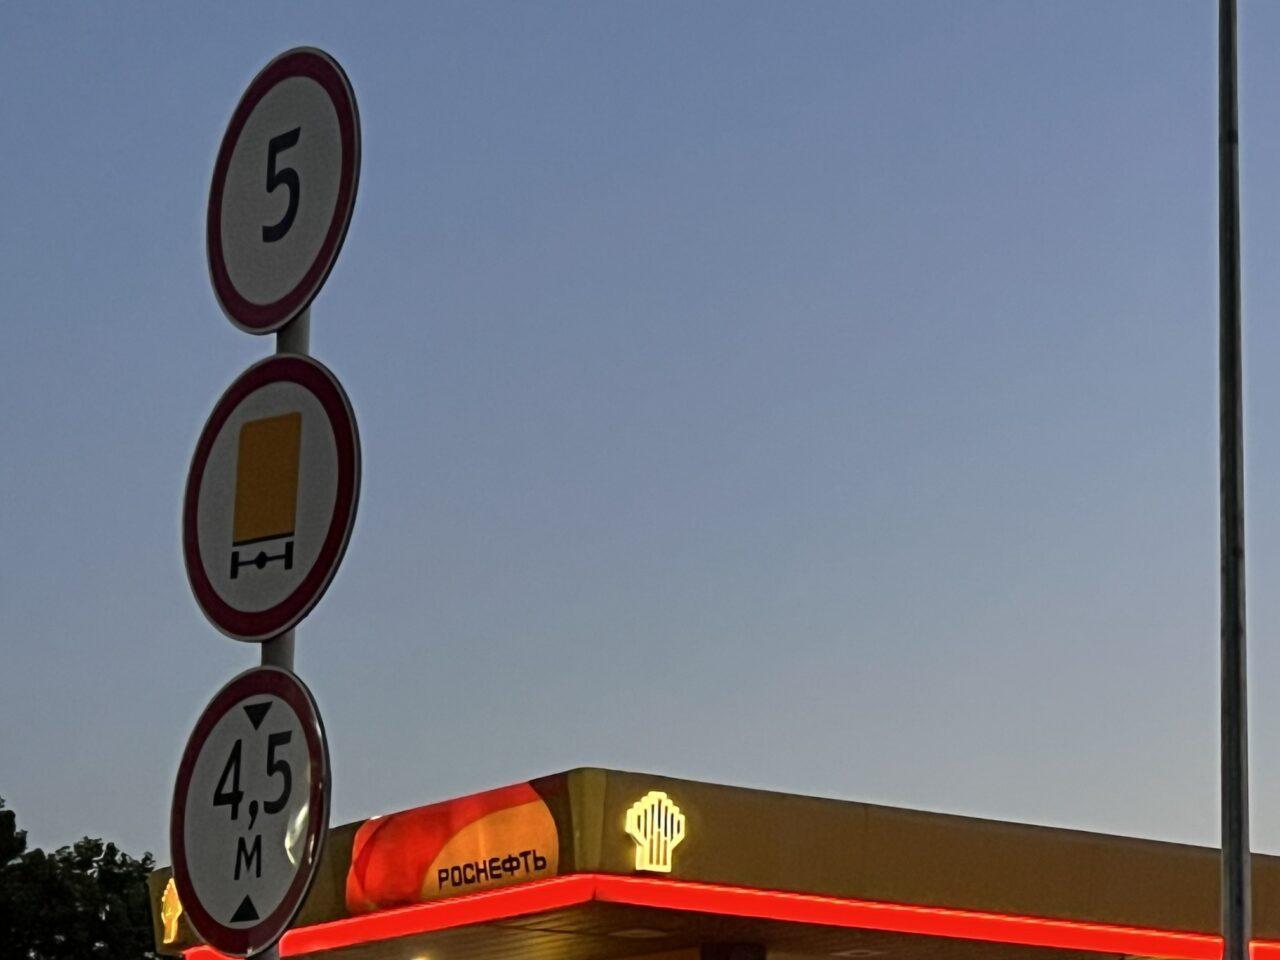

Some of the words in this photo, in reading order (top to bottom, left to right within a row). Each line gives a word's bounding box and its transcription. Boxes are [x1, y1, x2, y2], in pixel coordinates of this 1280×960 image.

[261, 125, 302, 243] 5
[212, 729, 293, 831] 4,5
[233, 833, 262, 881] М
[437, 849, 547, 890] РОСНЕФТЬ
